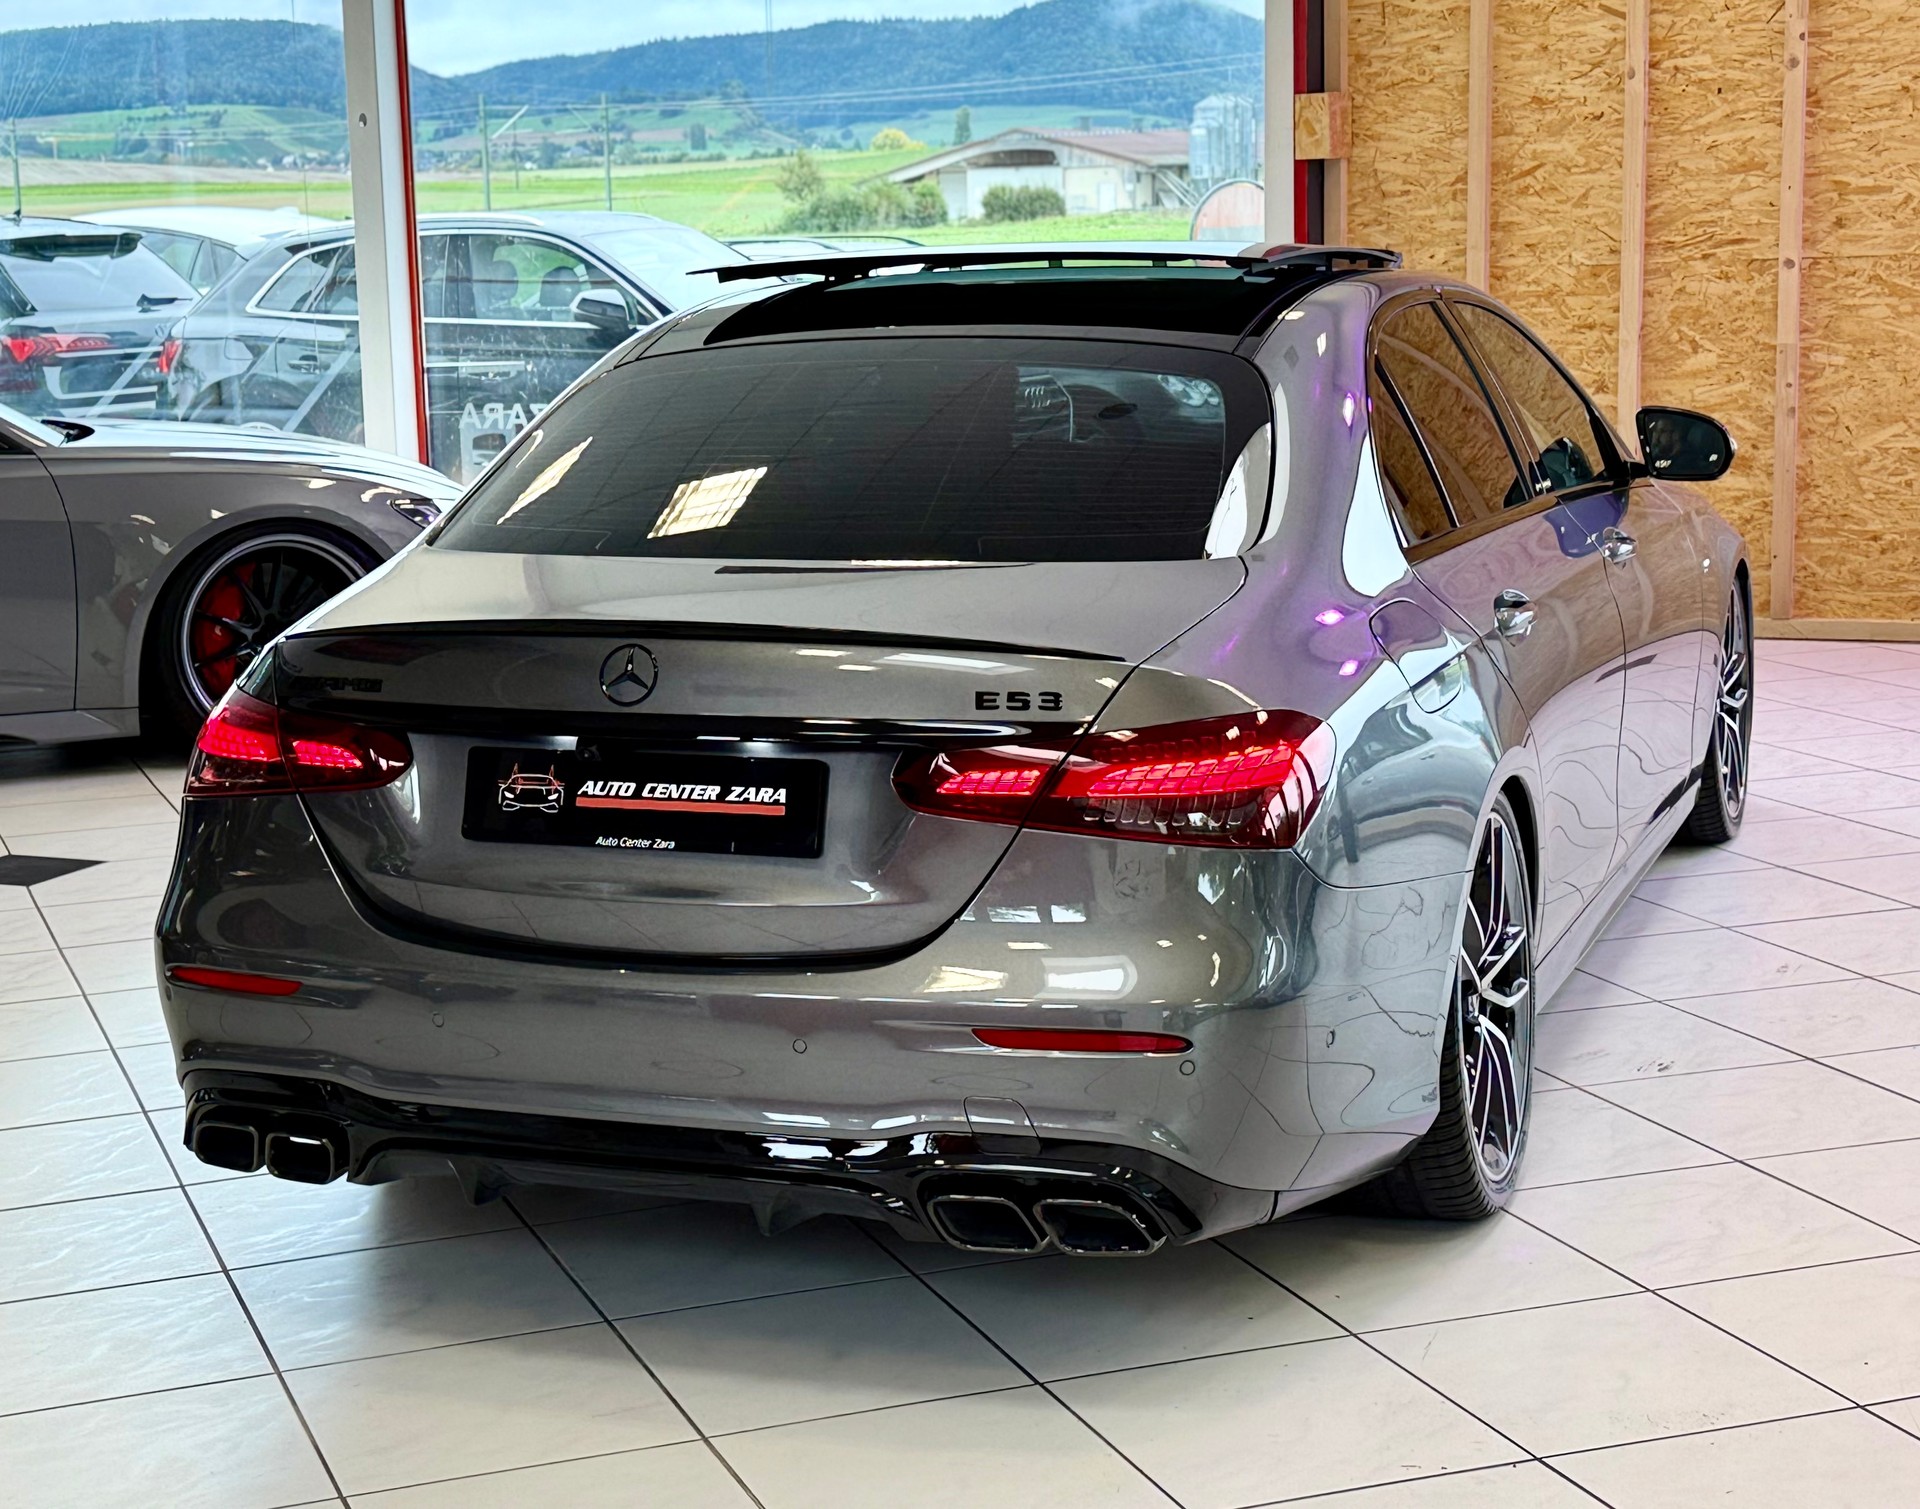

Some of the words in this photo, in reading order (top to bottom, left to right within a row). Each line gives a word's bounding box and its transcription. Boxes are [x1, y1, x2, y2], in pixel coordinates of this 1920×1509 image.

[975, 691, 1063, 711] E53
[577, 780, 637, 797] AUTO
[641, 783, 721, 801] CENTER
[725, 786, 787, 804] ZARA
[595, 836, 618, 847] Auto
[620, 837, 652, 849] Center
[653, 838, 675, 850] Zara
